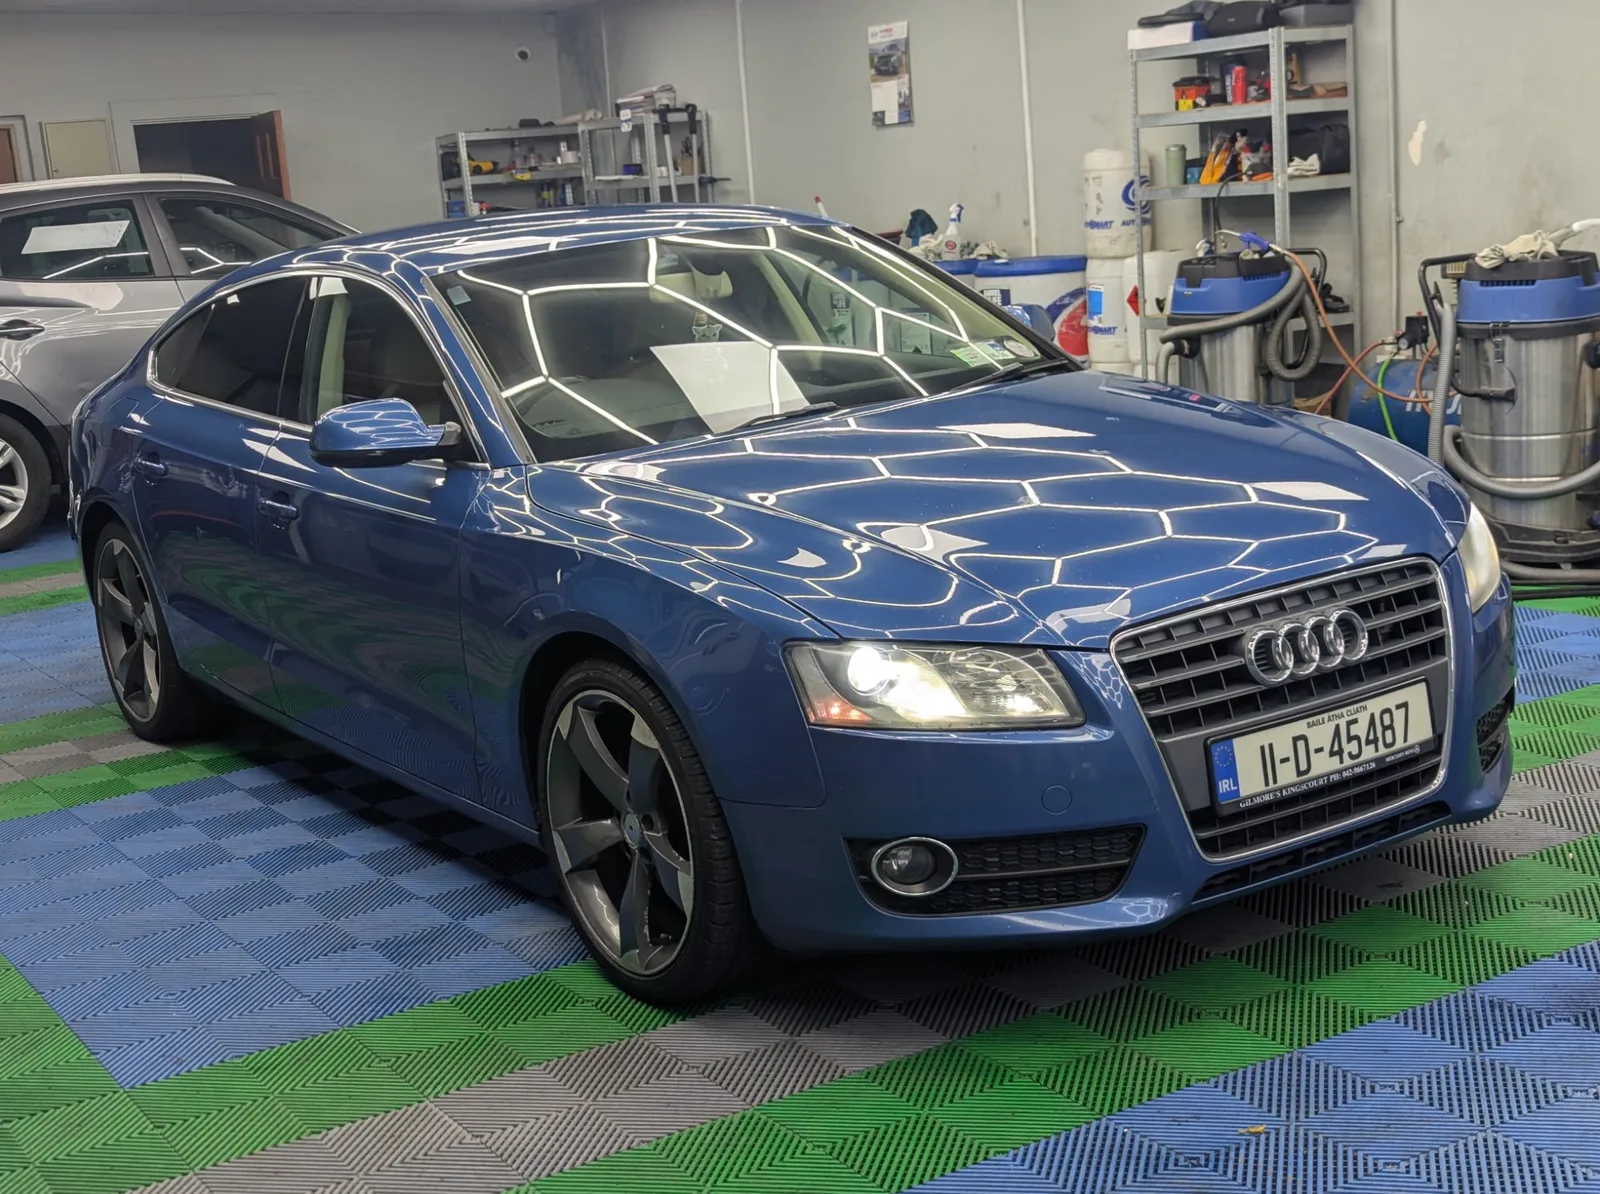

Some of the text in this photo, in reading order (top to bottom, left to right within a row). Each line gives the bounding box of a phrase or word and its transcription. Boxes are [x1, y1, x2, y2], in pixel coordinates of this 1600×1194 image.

[1306, 717, 1326, 729] BAILE
[1346, 704, 1368, 717] CLIATH
[1259, 701, 1410, 788] 11-D-45487
[1218, 778, 1238, 794] IRL
[1239, 790, 1281, 808] GILMORE'S
[1282, 776, 1329, 796] KINGSCOURT
[1329, 773, 1342, 784] PH:
